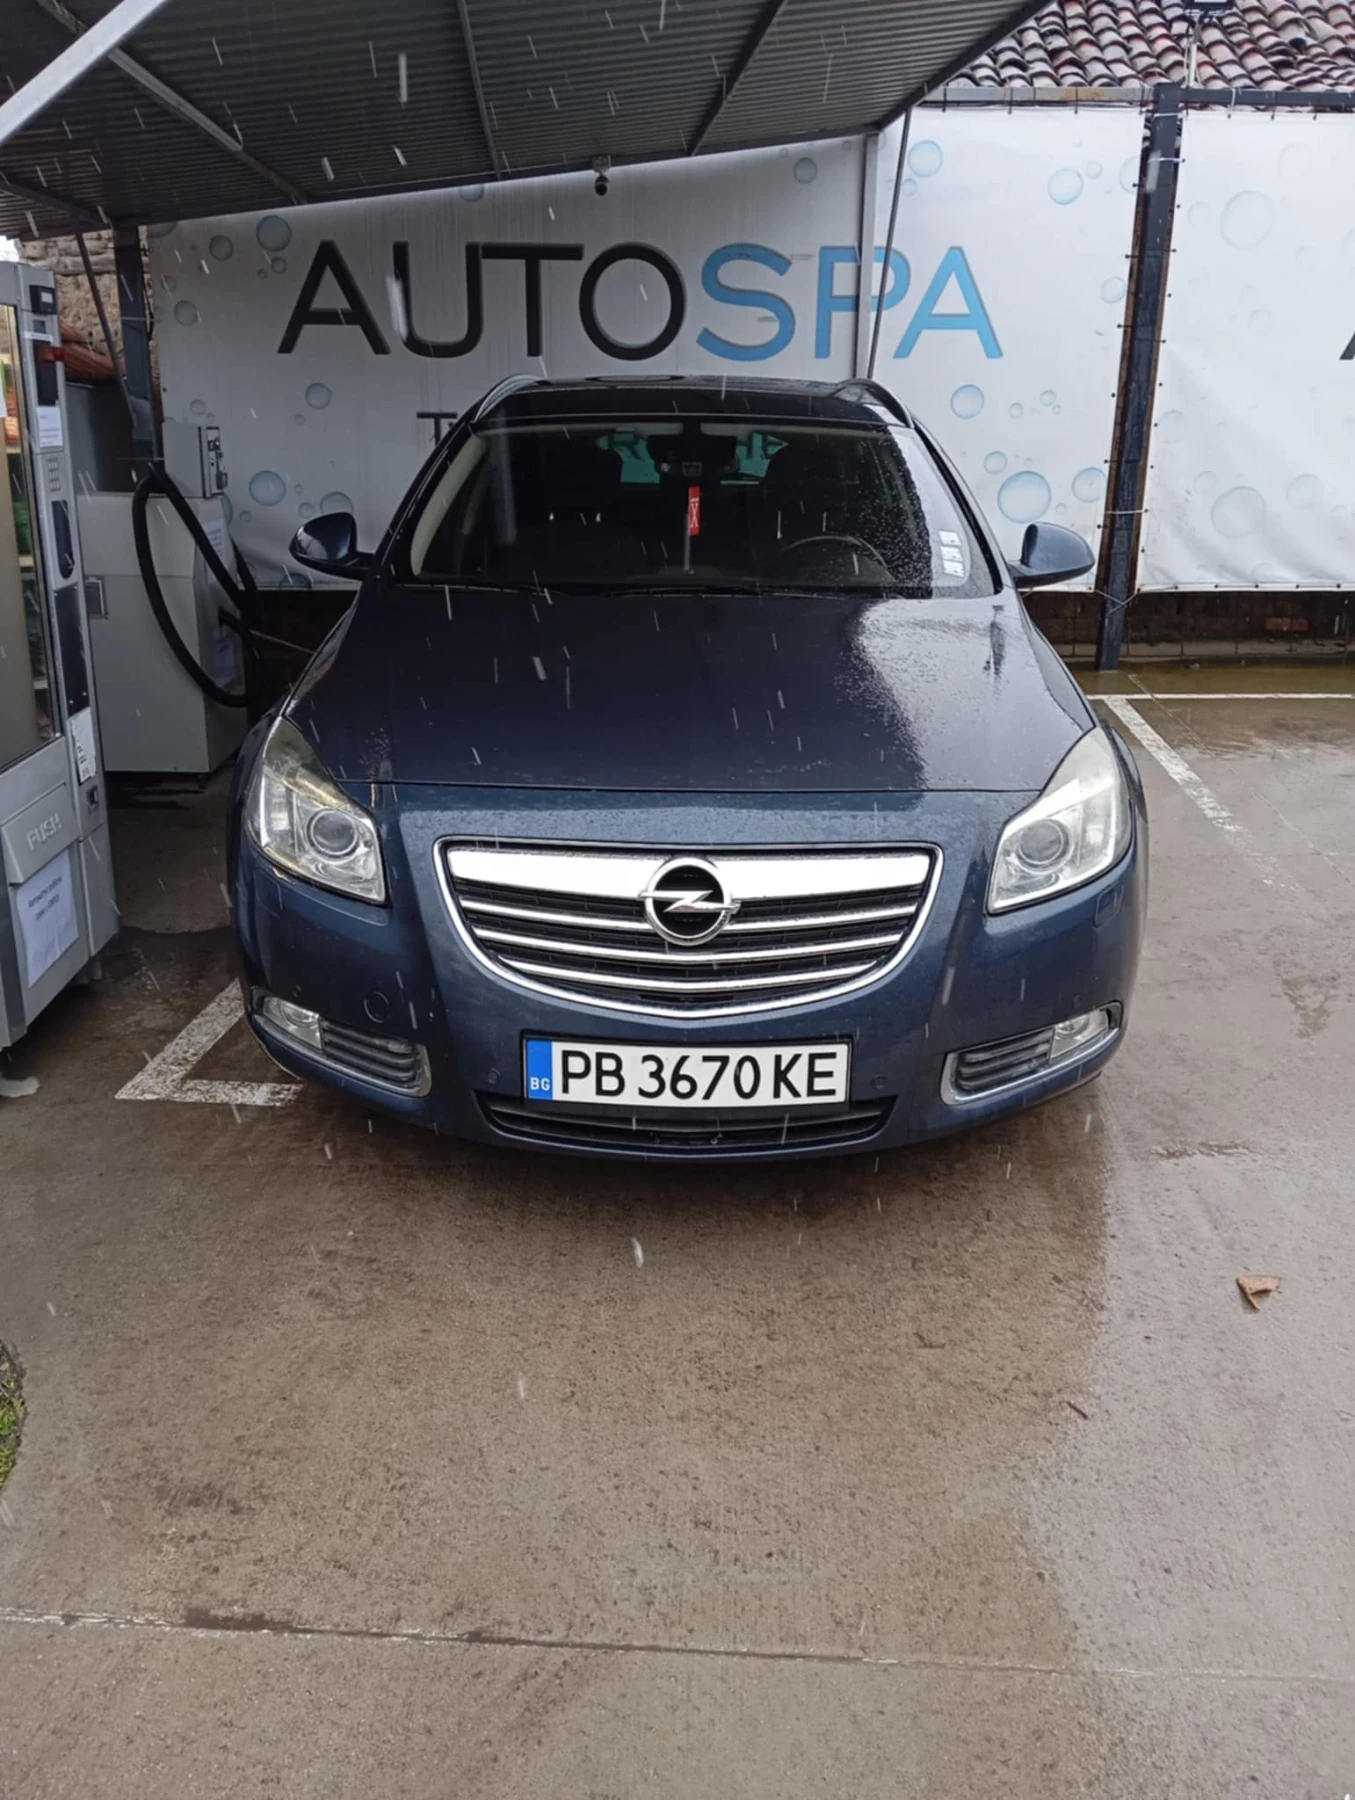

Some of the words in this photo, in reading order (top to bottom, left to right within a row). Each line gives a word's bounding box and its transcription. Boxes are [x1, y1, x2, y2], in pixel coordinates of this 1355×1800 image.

[278, 239, 1004, 362] AUTOSPA
[27, 812, 62, 851] PUSH
[530, 1077, 551, 1091] BG
